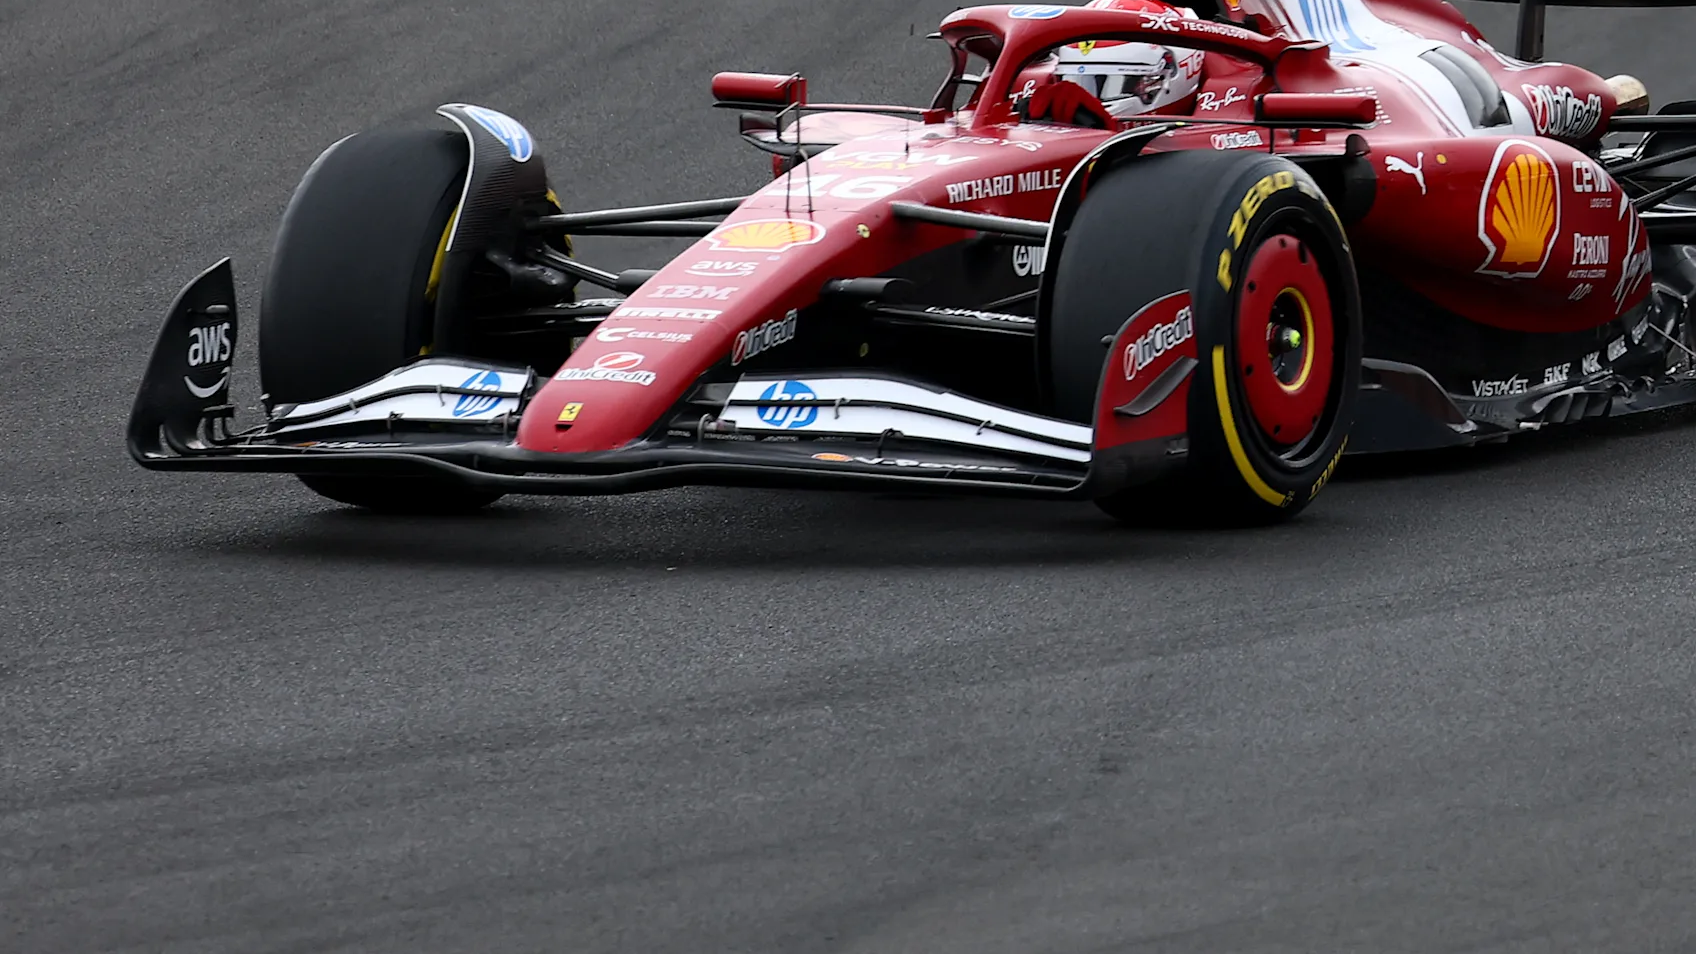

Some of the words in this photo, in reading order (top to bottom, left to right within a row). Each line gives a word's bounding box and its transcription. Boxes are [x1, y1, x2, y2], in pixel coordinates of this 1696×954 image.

[1139, 14, 1180, 32] DXC
[1197, 87, 1246, 112] Ray-Ban
[764, 173, 913, 199] 16
[945, 173, 1014, 204] RICHARD
[1017, 168, 1062, 193] MILLE
[1216, 247, 1233, 293] P
[1227, 170, 1295, 251] ZERO
[1572, 233, 1610, 265] PERONI
[690, 260, 760, 272] aws
[650, 284, 741, 300] IBM
[613, 307, 723, 320] PIRELLI
[187, 321, 231, 367] aws
[626, 331, 695, 343] CELSIUS
[1134, 306, 1194, 371] UniCredit
[554, 367, 657, 386] UniCredit
[1471, 374, 1529, 397] VISTAJET
[1543, 362, 1571, 385] SKF
[757, 380, 819, 429] hp
